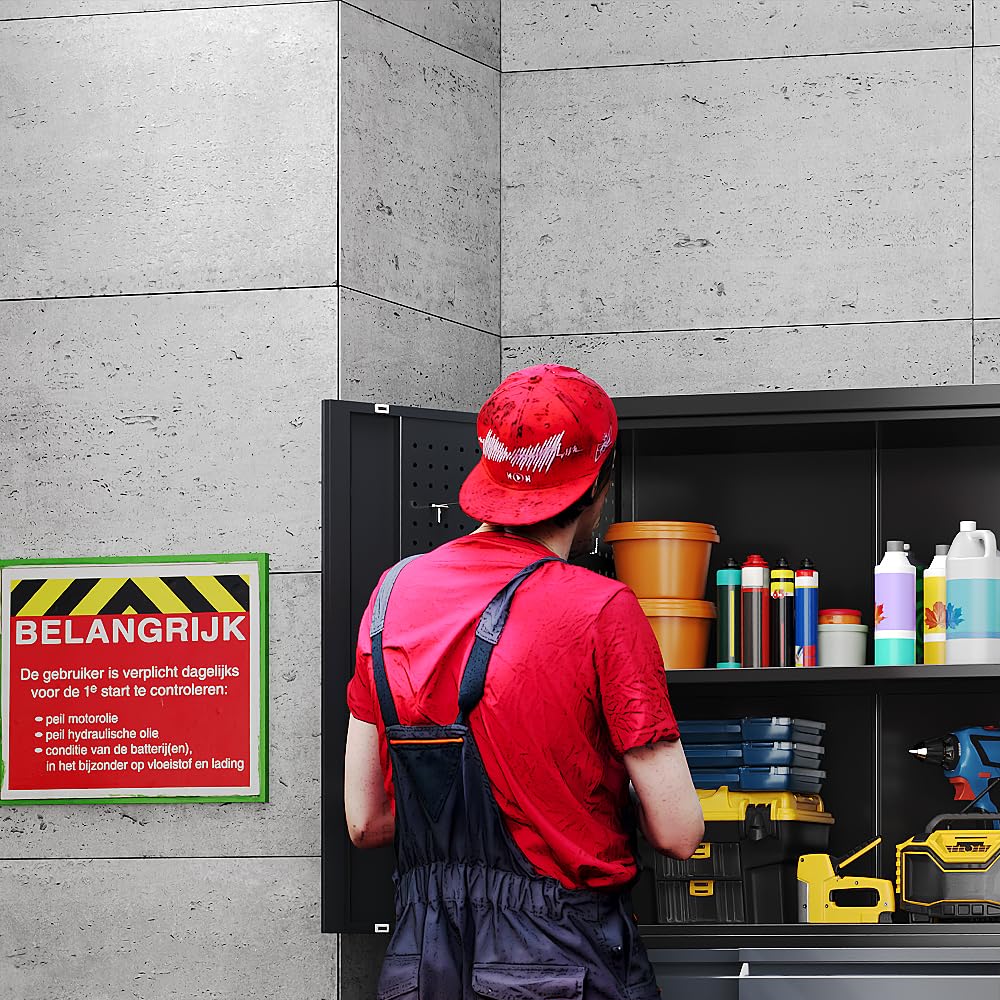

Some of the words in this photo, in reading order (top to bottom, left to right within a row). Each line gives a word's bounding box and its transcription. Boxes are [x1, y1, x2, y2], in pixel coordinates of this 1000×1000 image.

[16, 616, 246, 645] BELANGRIJK
[20, 668, 40, 681] De
[42, 667, 105, 684] gebruiker
[108, 667, 120, 680] is
[122, 666, 179, 682] verplicht
[181, 665, 240, 681] dagelijks
[30, 689, 61, 699] voor
[63, 686, 81, 698] de
[100, 685, 131, 698] start
[133, 685, 147, 697] te
[149, 683, 228, 697] controleren:
[45, 714, 65, 727] peil
[67, 713, 119, 725] motorolie
[45, 729, 65, 743] peil
[67, 728, 137, 743] hydraulische
[139, 728, 160, 739] olie
[45, 745, 88, 756] conditie
[90, 746, 111, 756] van
[113, 744, 128, 755] de
[130, 743, 193, 757] batterij(en),
[46, 761, 56, 772] in
[58, 761, 77, 772] het
[78, 760, 129, 774] bijzonder
[130, 762, 145, 773] op
[146, 758, 193, 770] vloeistof
[194, 760, 209, 770] en
[211, 758, 245, 772] lading
